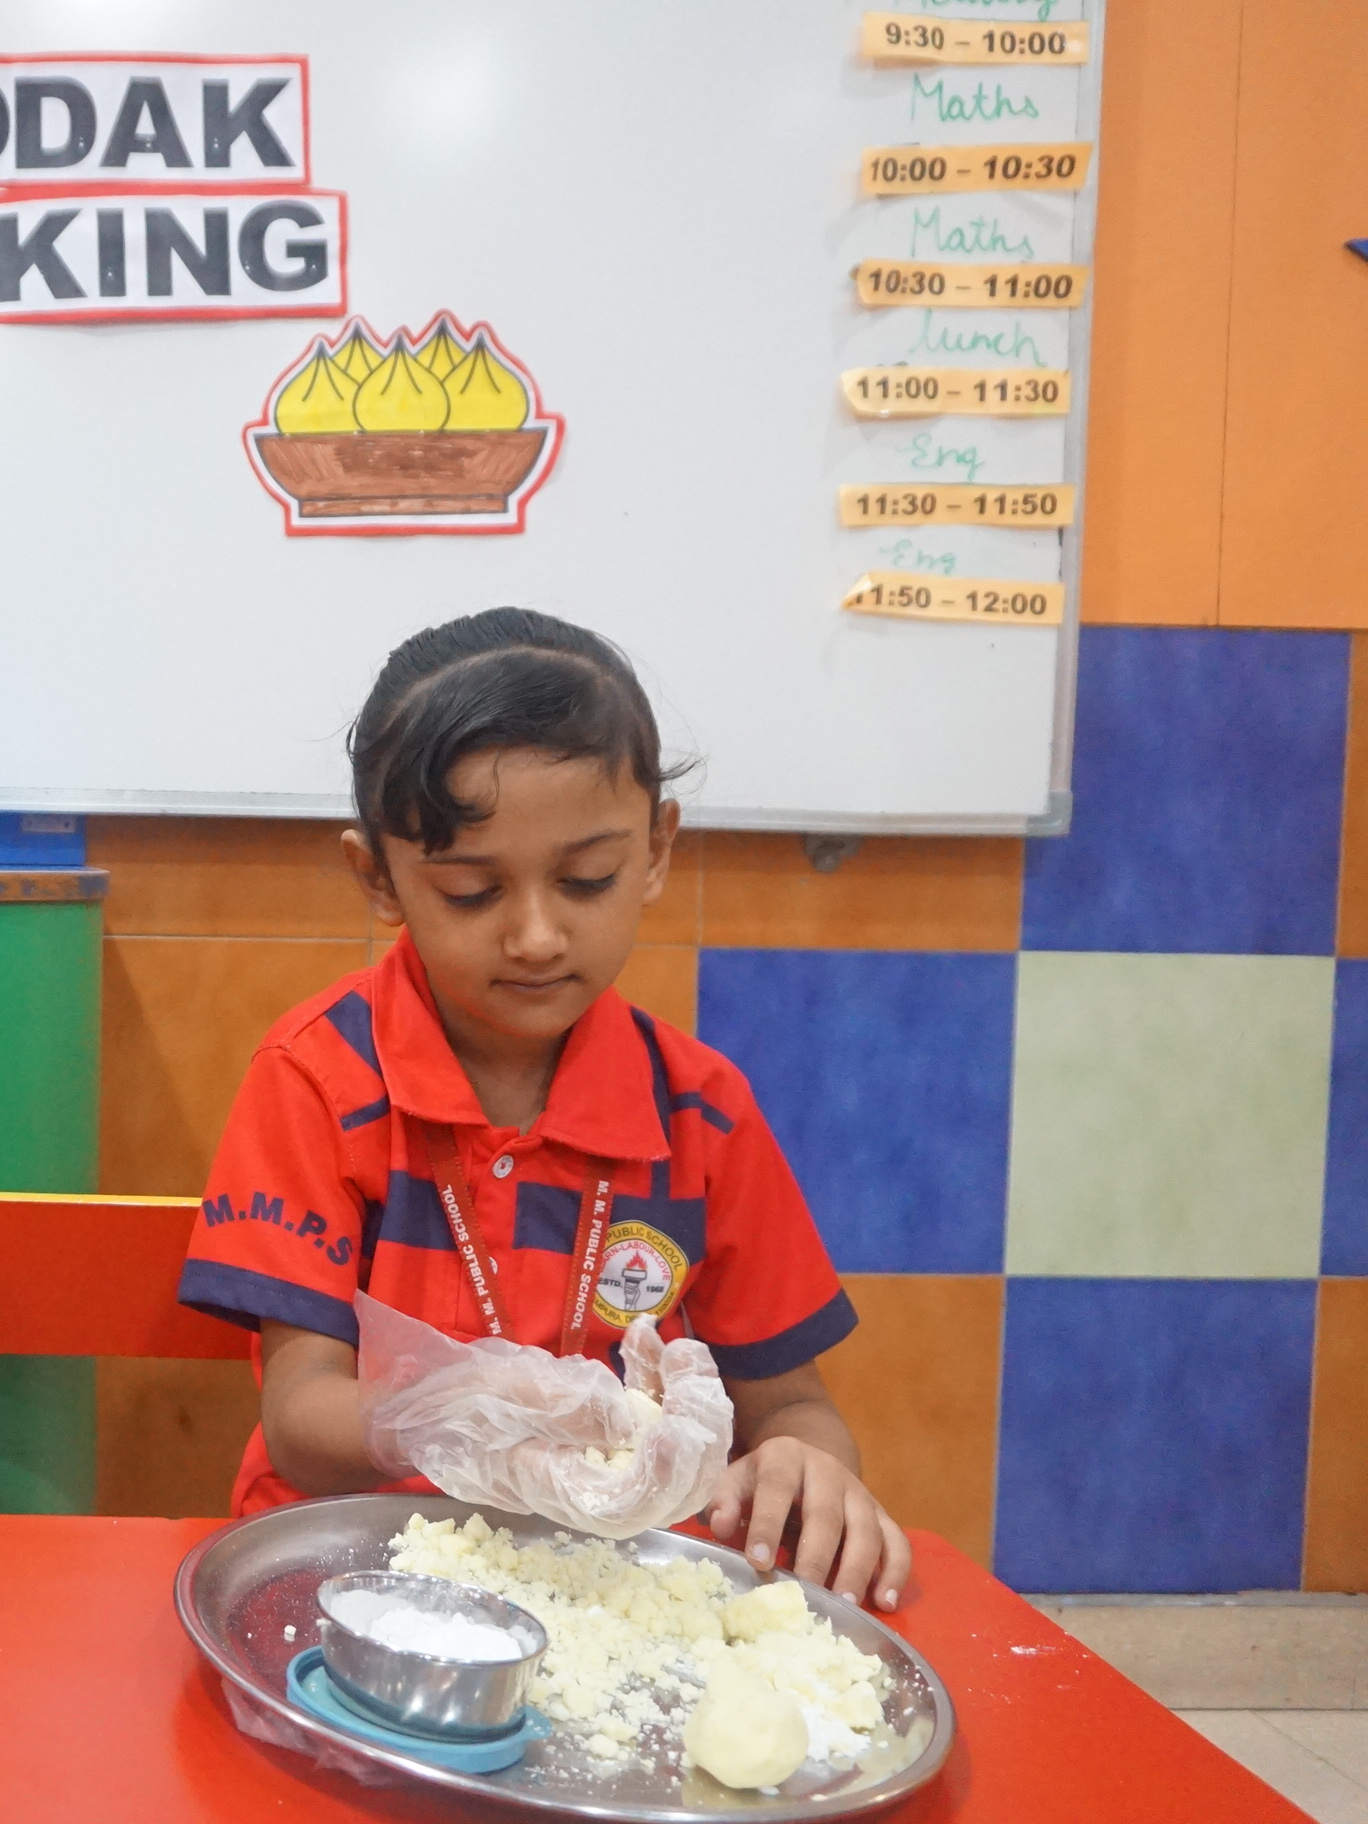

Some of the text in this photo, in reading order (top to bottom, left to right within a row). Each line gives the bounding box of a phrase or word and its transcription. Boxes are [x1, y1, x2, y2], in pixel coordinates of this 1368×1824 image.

[885, 22, 945, 50] 9:30
[982, 30, 1067, 55] 10:00
[910, 72, 1040, 122] Maths
[869, 157, 948, 182] 10:00
[983, 154, 1077, 180] 10:30
[911, 205, 1036, 259] Maths
[869, 268, 946, 295] 10:30
[983, 273, 1074, 299] 11:00
[856, 376, 939, 400] 11:00
[973, 379, 1060, 403] 11:30
[856, 493, 937, 515] 11:30
[973, 493, 1058, 515] 11:50
[965, 590, 1048, 616] 12:00
[203, 1191, 353, 1266] M.M.P.S
[442, 1184, 470, 1242] SCHOOL
[583, 1218, 603, 1271] PUBLIC
[646, 1230, 683, 1271] SCHOOL
[462, 1244, 489, 1297] PUBLIC
[570, 1273, 592, 1331] SCHOOL
